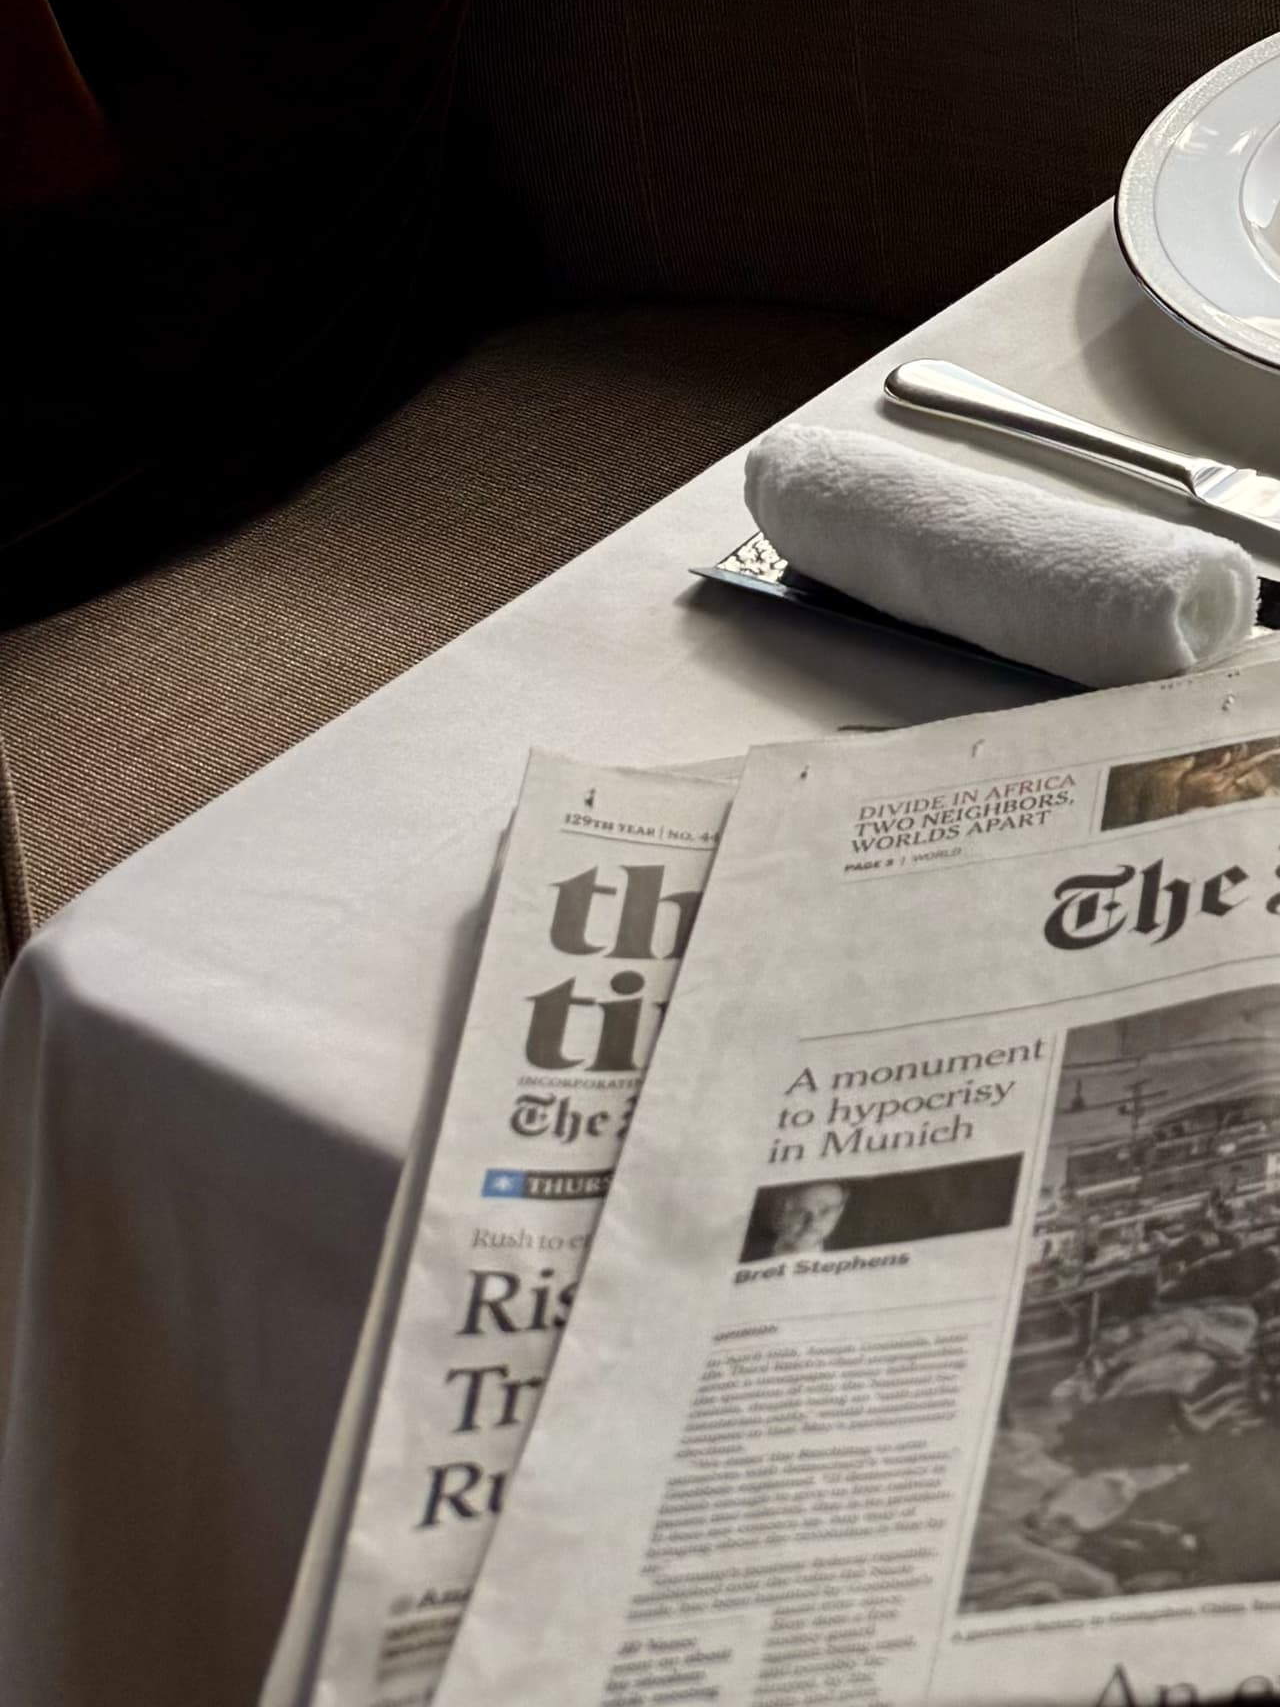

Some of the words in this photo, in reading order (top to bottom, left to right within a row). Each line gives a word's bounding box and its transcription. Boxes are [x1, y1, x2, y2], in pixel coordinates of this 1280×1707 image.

[854, 815, 914, 837] TWO
[921, 790, 1075, 828] NEIGHBORS,
[858, 795, 945, 821] DIVIDE
[952, 788, 978, 805] IN
[984, 773, 1076, 801] AFRICA
[619, 823, 656, 837] YEAR
[851, 823, 960, 854] WORLDS
[965, 810, 1052, 836] APART
[844, 859, 881, 872] PAGE
[1044, 858, 1249, 950] The
[784, 1066, 818, 1096] A
[832, 1038, 1046, 1090] monument
[510, 1093, 609, 1143] The
[777, 1106, 815, 1130] to
[827, 1079, 1017, 1127] hypocrisy
[767, 1138, 805, 1164] in
[820, 1113, 974, 1158] Munich
[472, 1228, 532, 1249] Rush
[538, 1233, 563, 1251] to
[733, 1261, 787, 1285] Bret
[792, 1251, 911, 1276] Stephens
